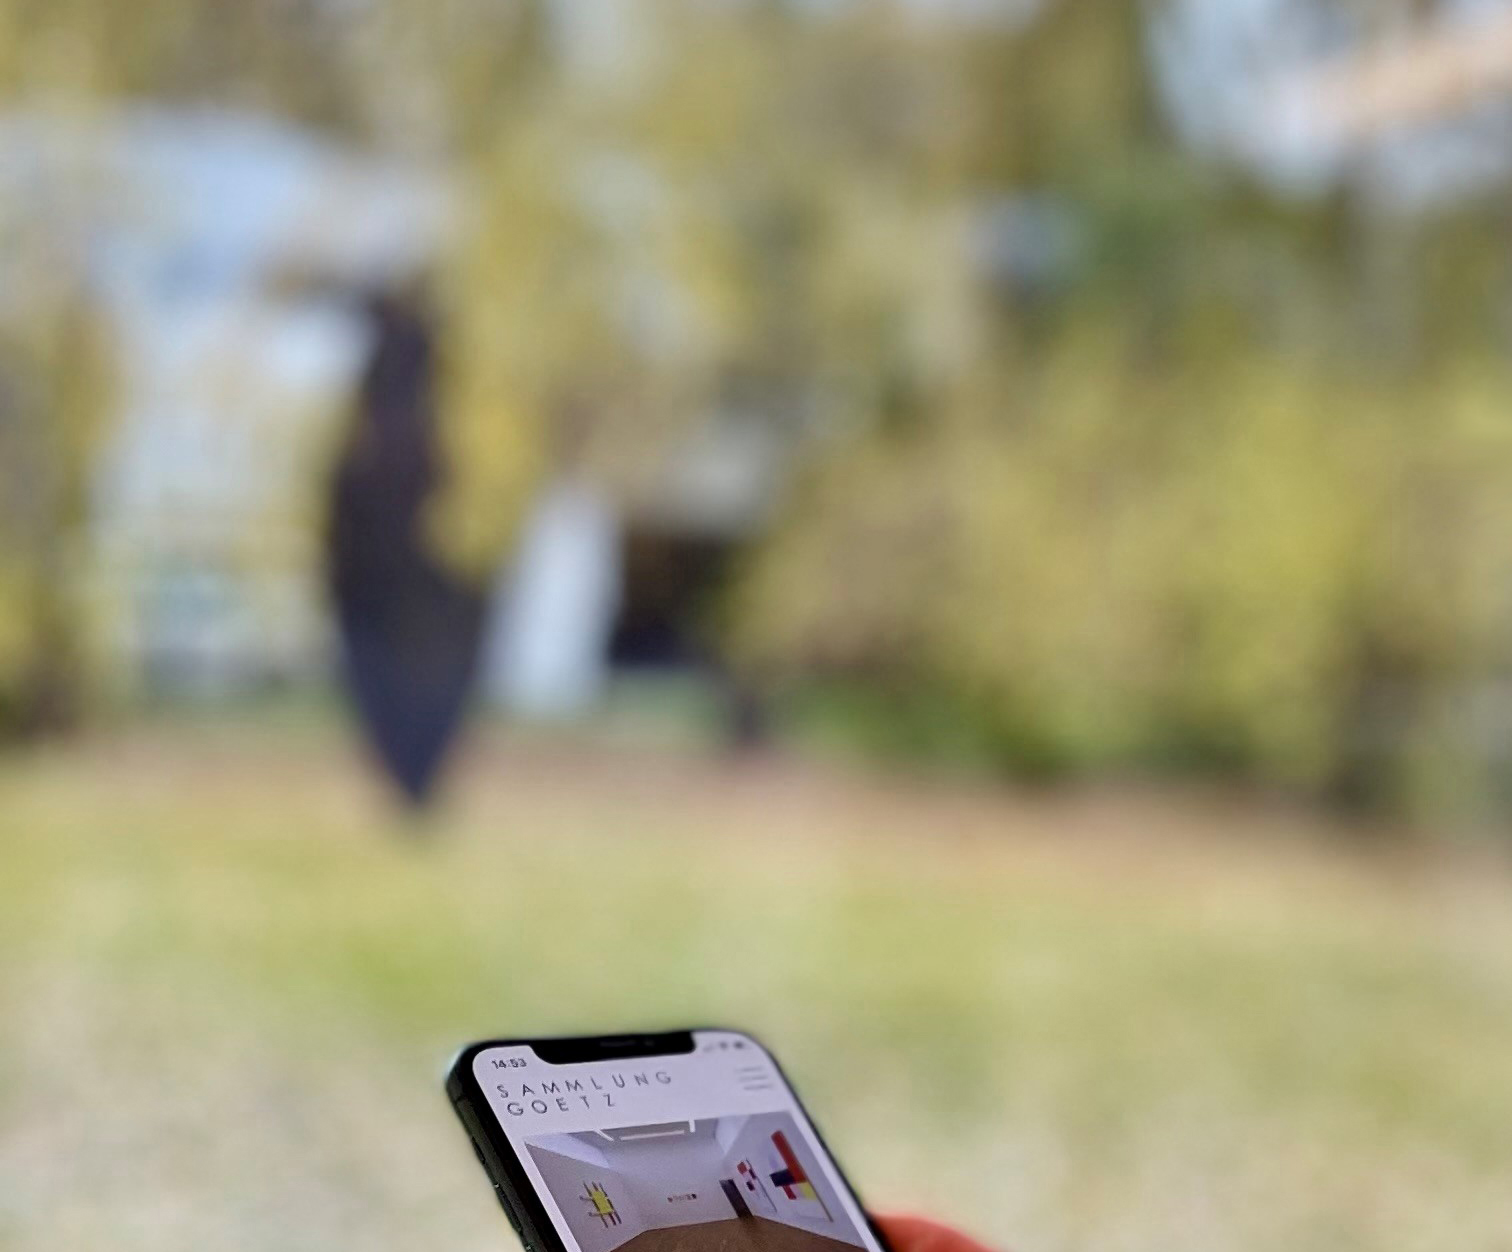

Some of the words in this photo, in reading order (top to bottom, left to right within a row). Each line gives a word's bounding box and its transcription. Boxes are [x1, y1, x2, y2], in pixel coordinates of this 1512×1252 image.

[491, 1058, 527, 1069] 14:53
[496, 1071, 672, 1099] SAMMLUNG
[506, 1093, 615, 1116] GOETZ
